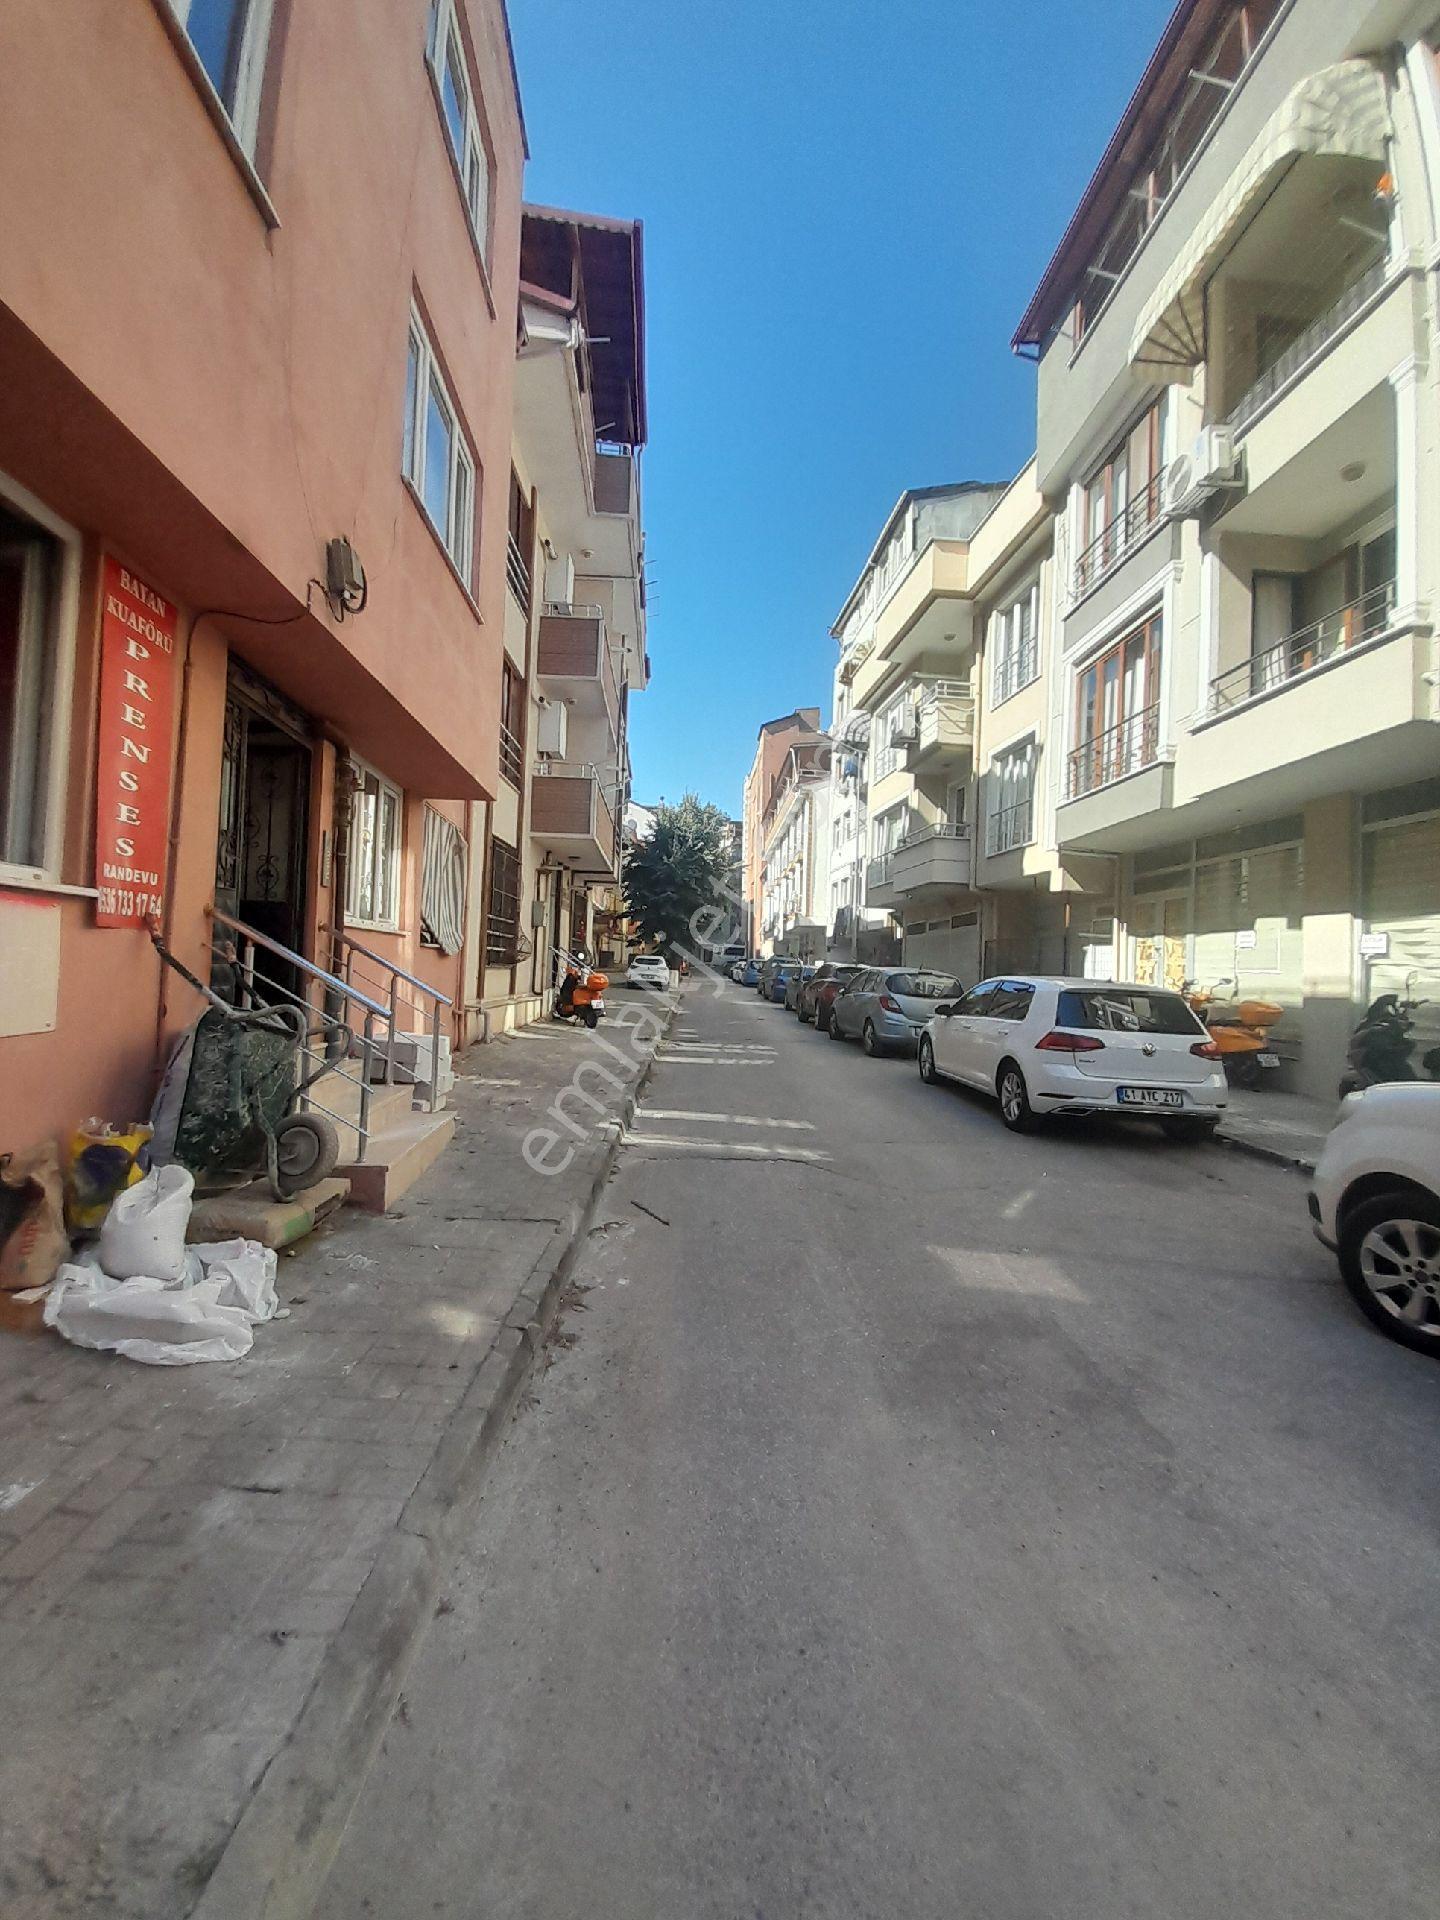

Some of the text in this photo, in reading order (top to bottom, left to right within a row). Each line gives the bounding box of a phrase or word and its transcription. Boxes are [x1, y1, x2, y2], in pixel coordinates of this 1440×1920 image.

[120, 568, 166, 618] BAYAN
[115, 636, 153, 857] PRENSES
[103, 862, 158, 886] RANDEVU
[1124, 1089, 1136, 1100] 41
